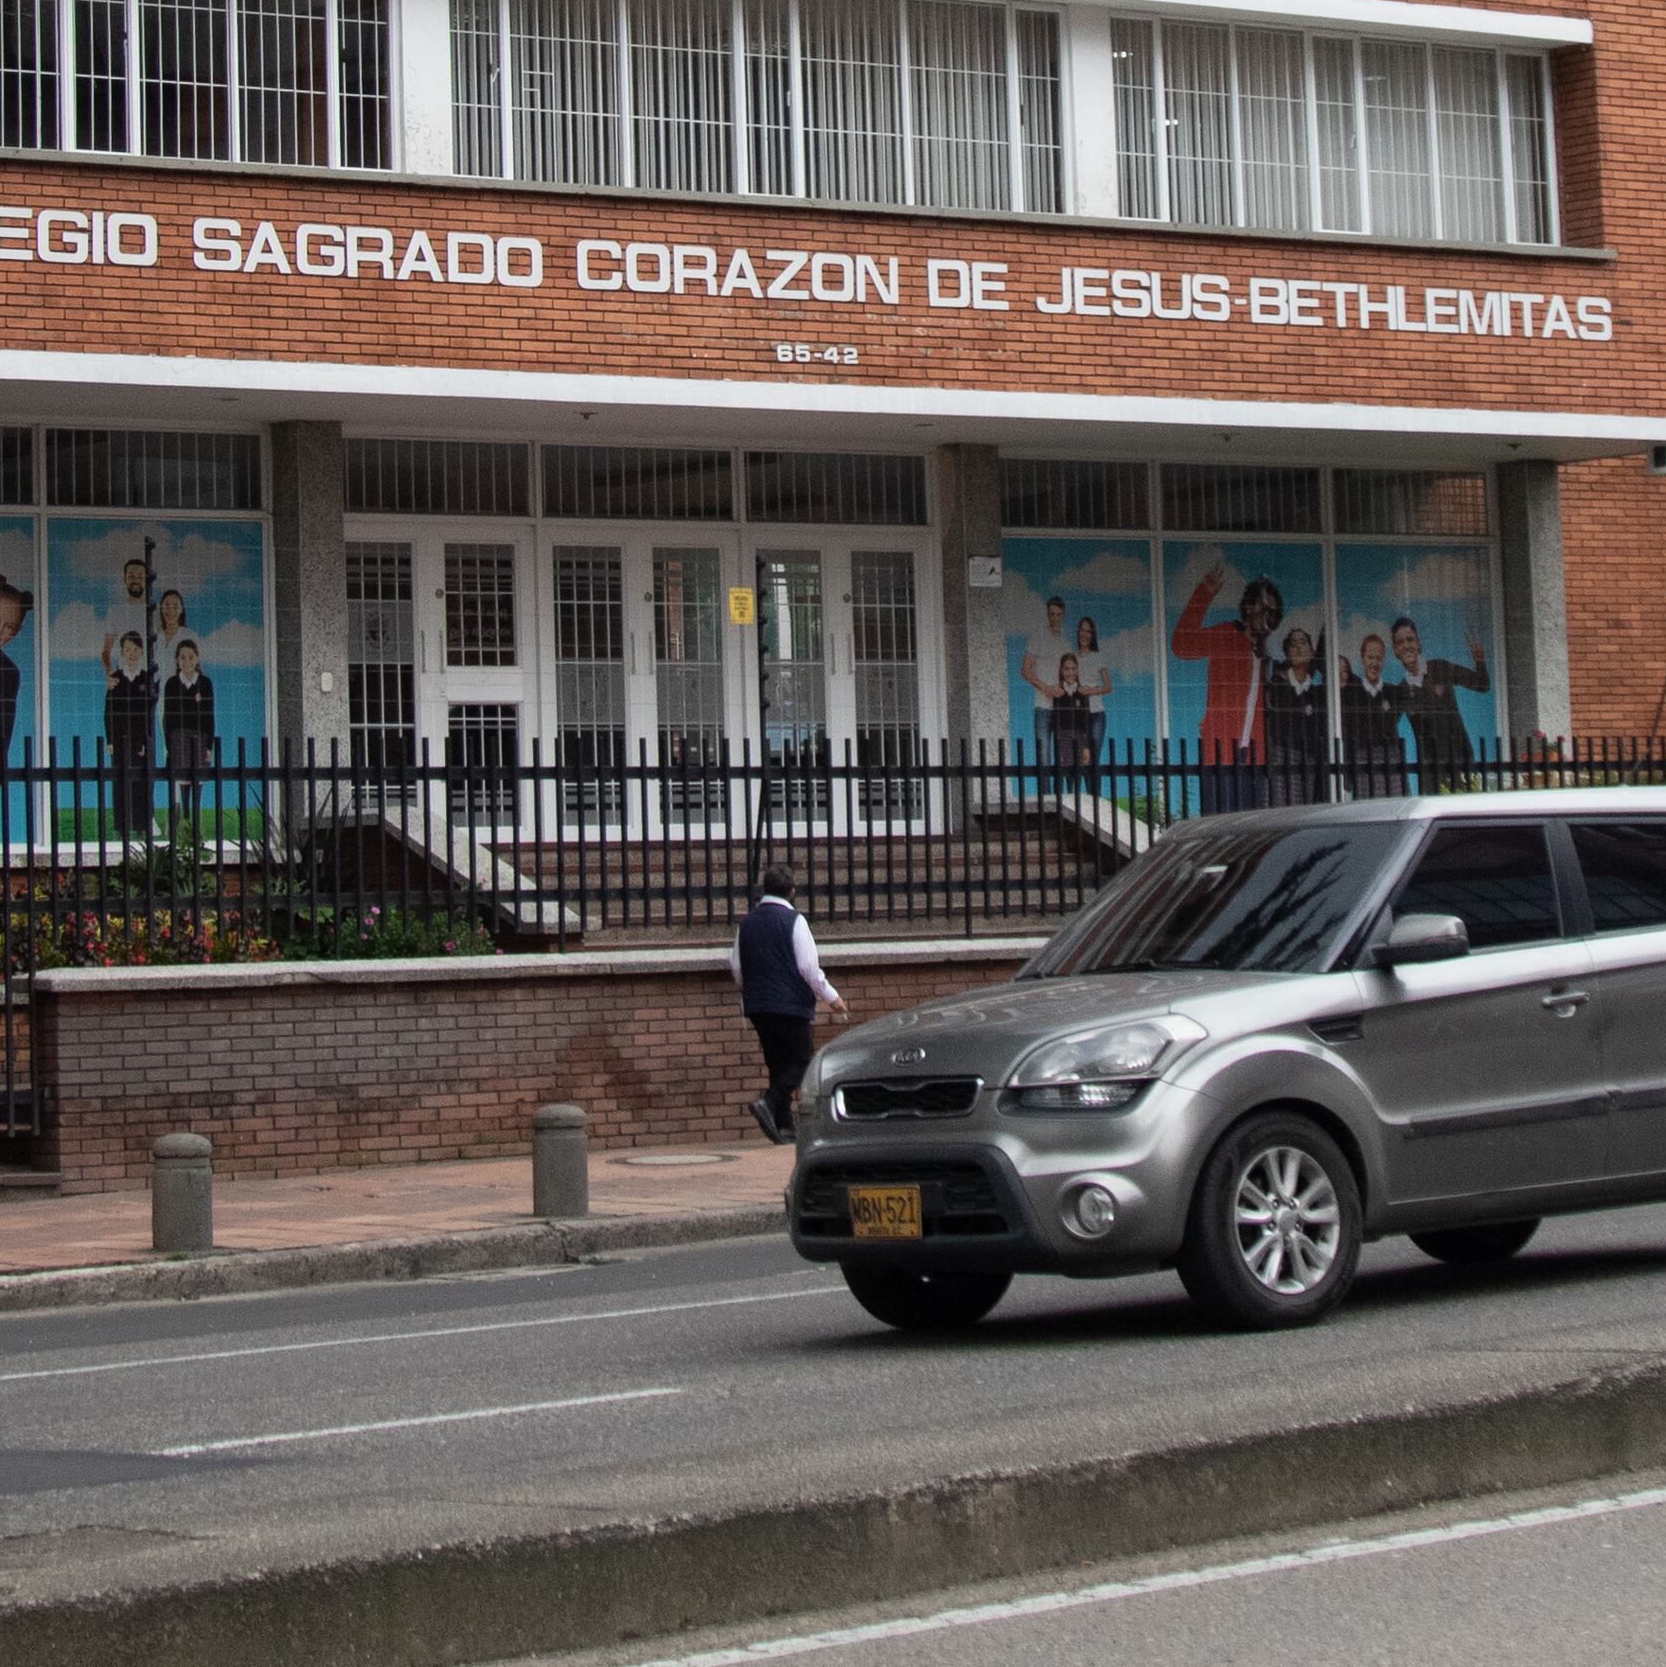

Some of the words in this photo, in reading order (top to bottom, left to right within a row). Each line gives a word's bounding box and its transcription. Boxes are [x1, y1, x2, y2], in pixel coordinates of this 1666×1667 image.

[193, 218, 543, 288] SAGRADO
[576, 239, 899, 305] CORAZON
[927, 259, 1010, 311] DE
[1035, 266, 1613, 341] JESUS-BETHLEMITAS
[776, 344, 859, 365] 65-42
